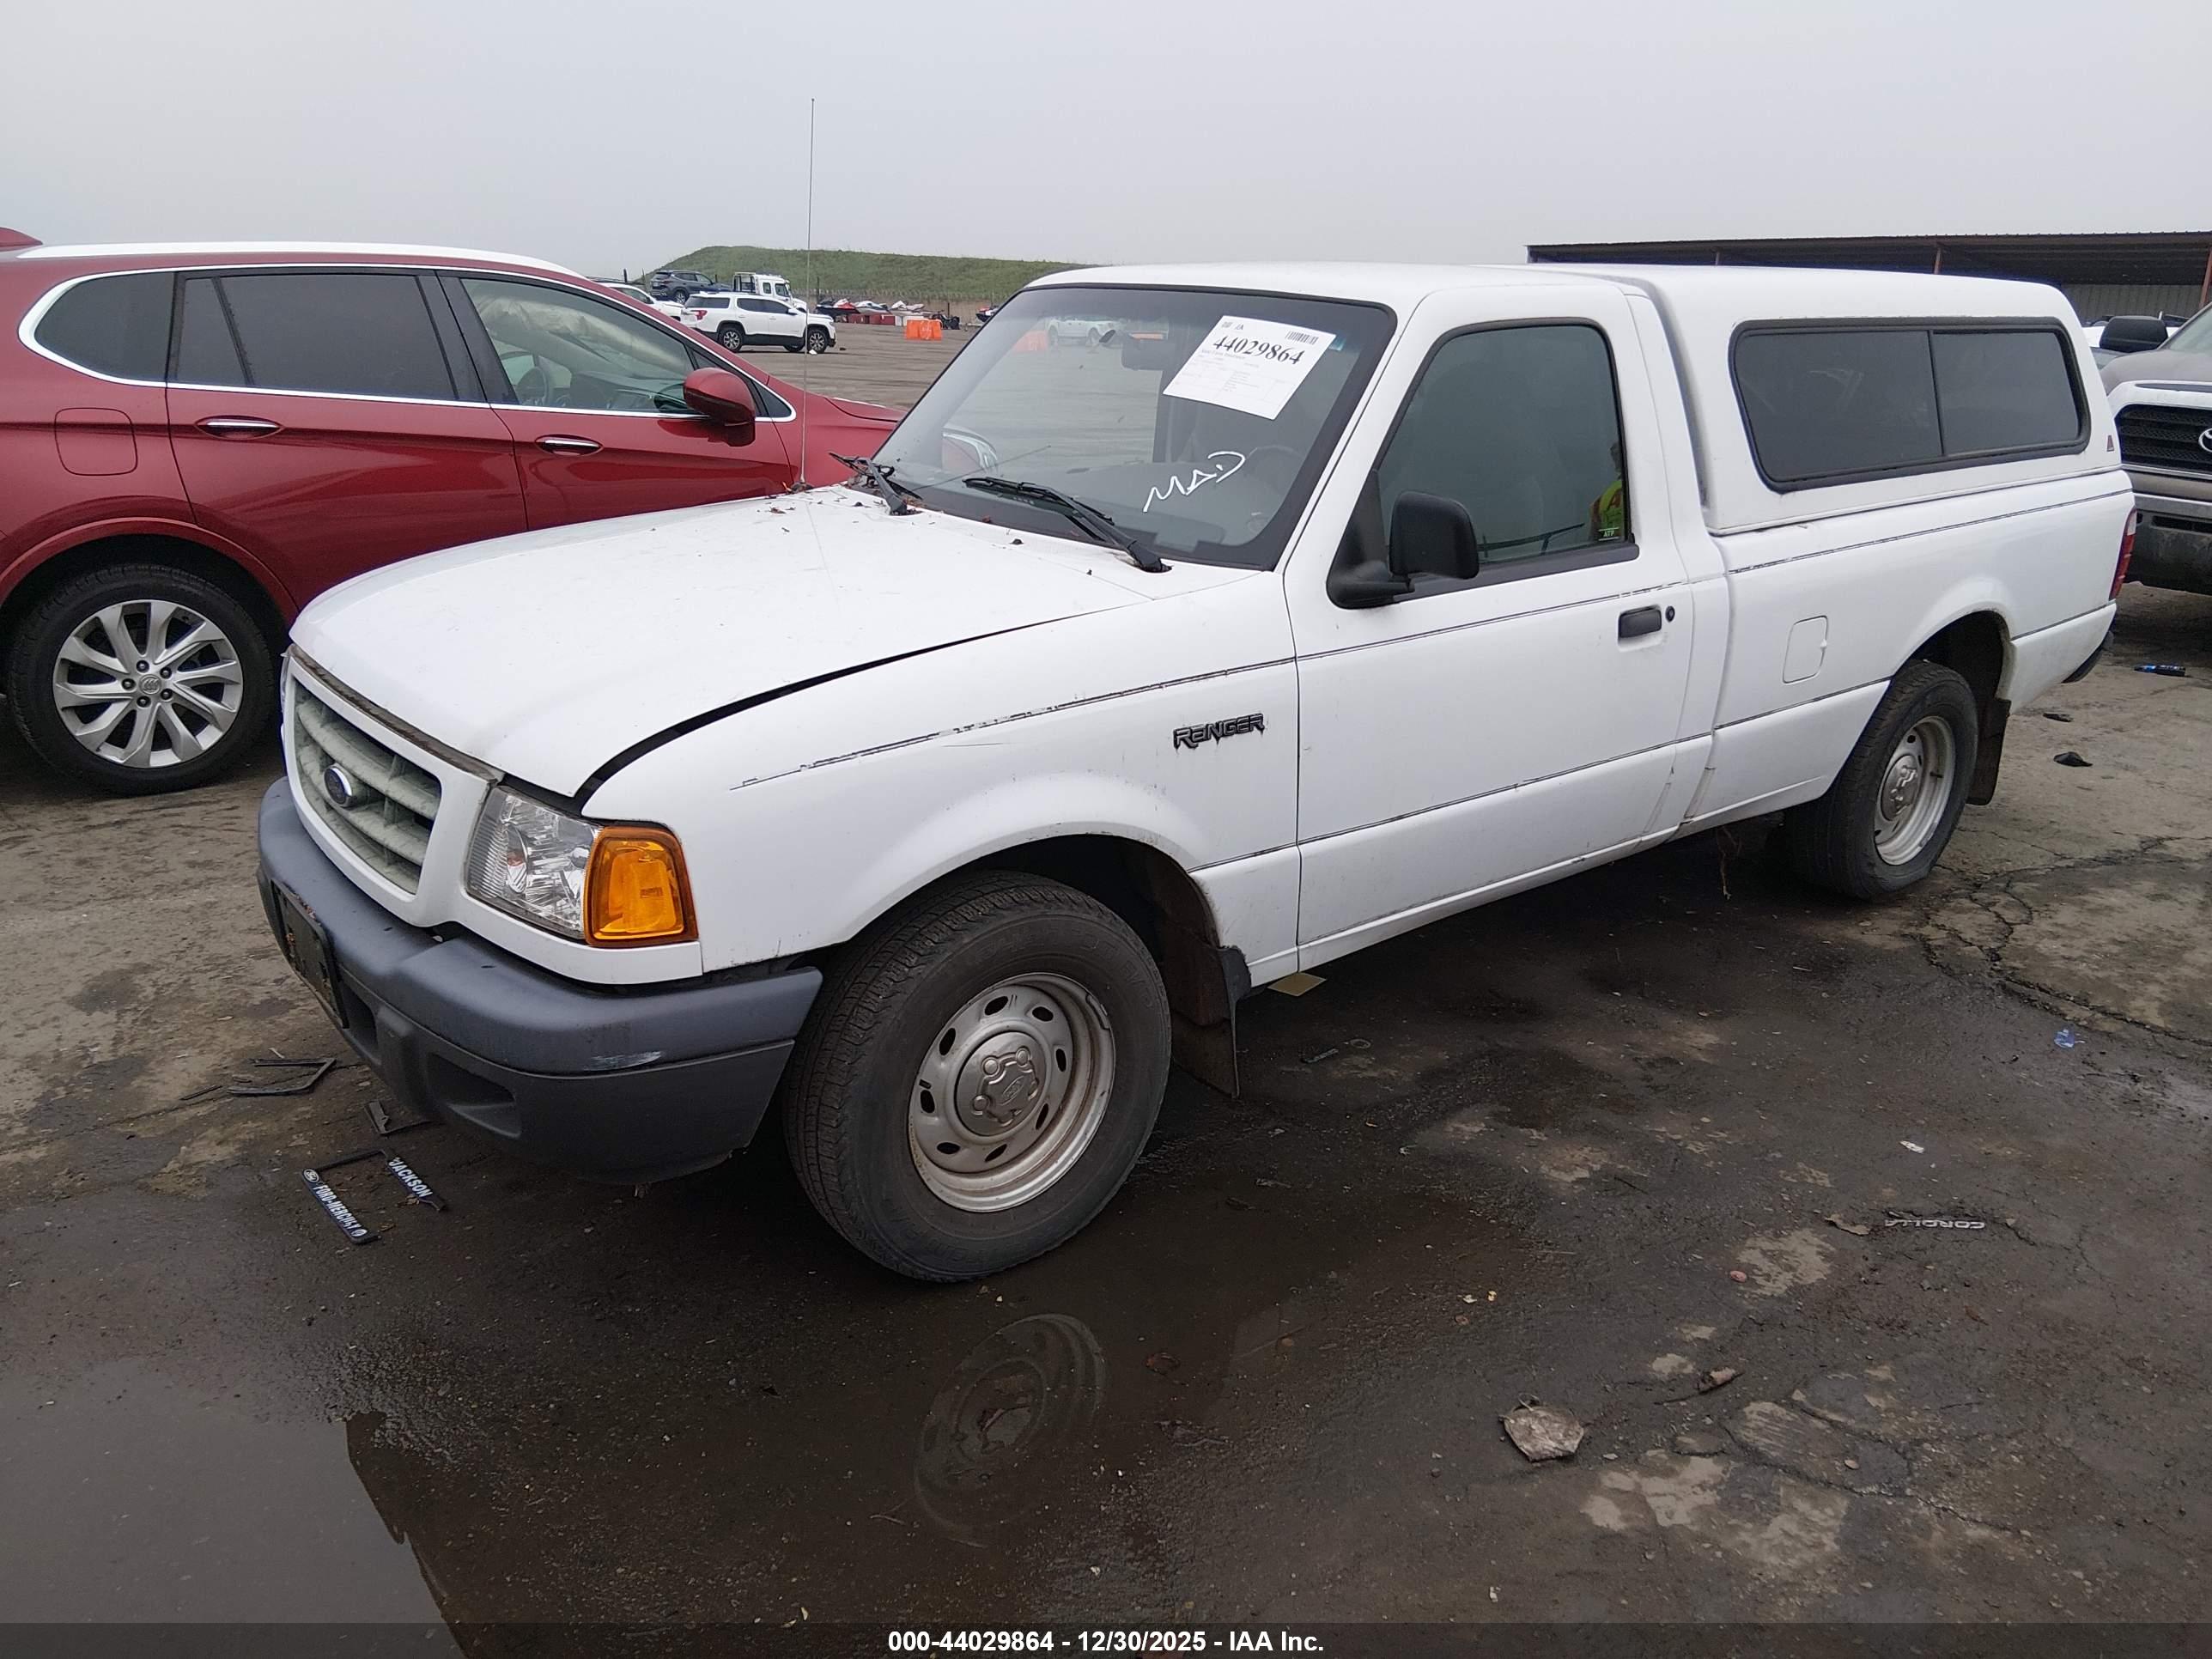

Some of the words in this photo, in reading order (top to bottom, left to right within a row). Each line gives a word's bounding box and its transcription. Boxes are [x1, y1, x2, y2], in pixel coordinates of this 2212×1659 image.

[1213, 335, 1304, 365] 44029864
[388, 1160, 434, 1198] JACKSON
[1885, 1218, 1985, 1230] COROLLA
